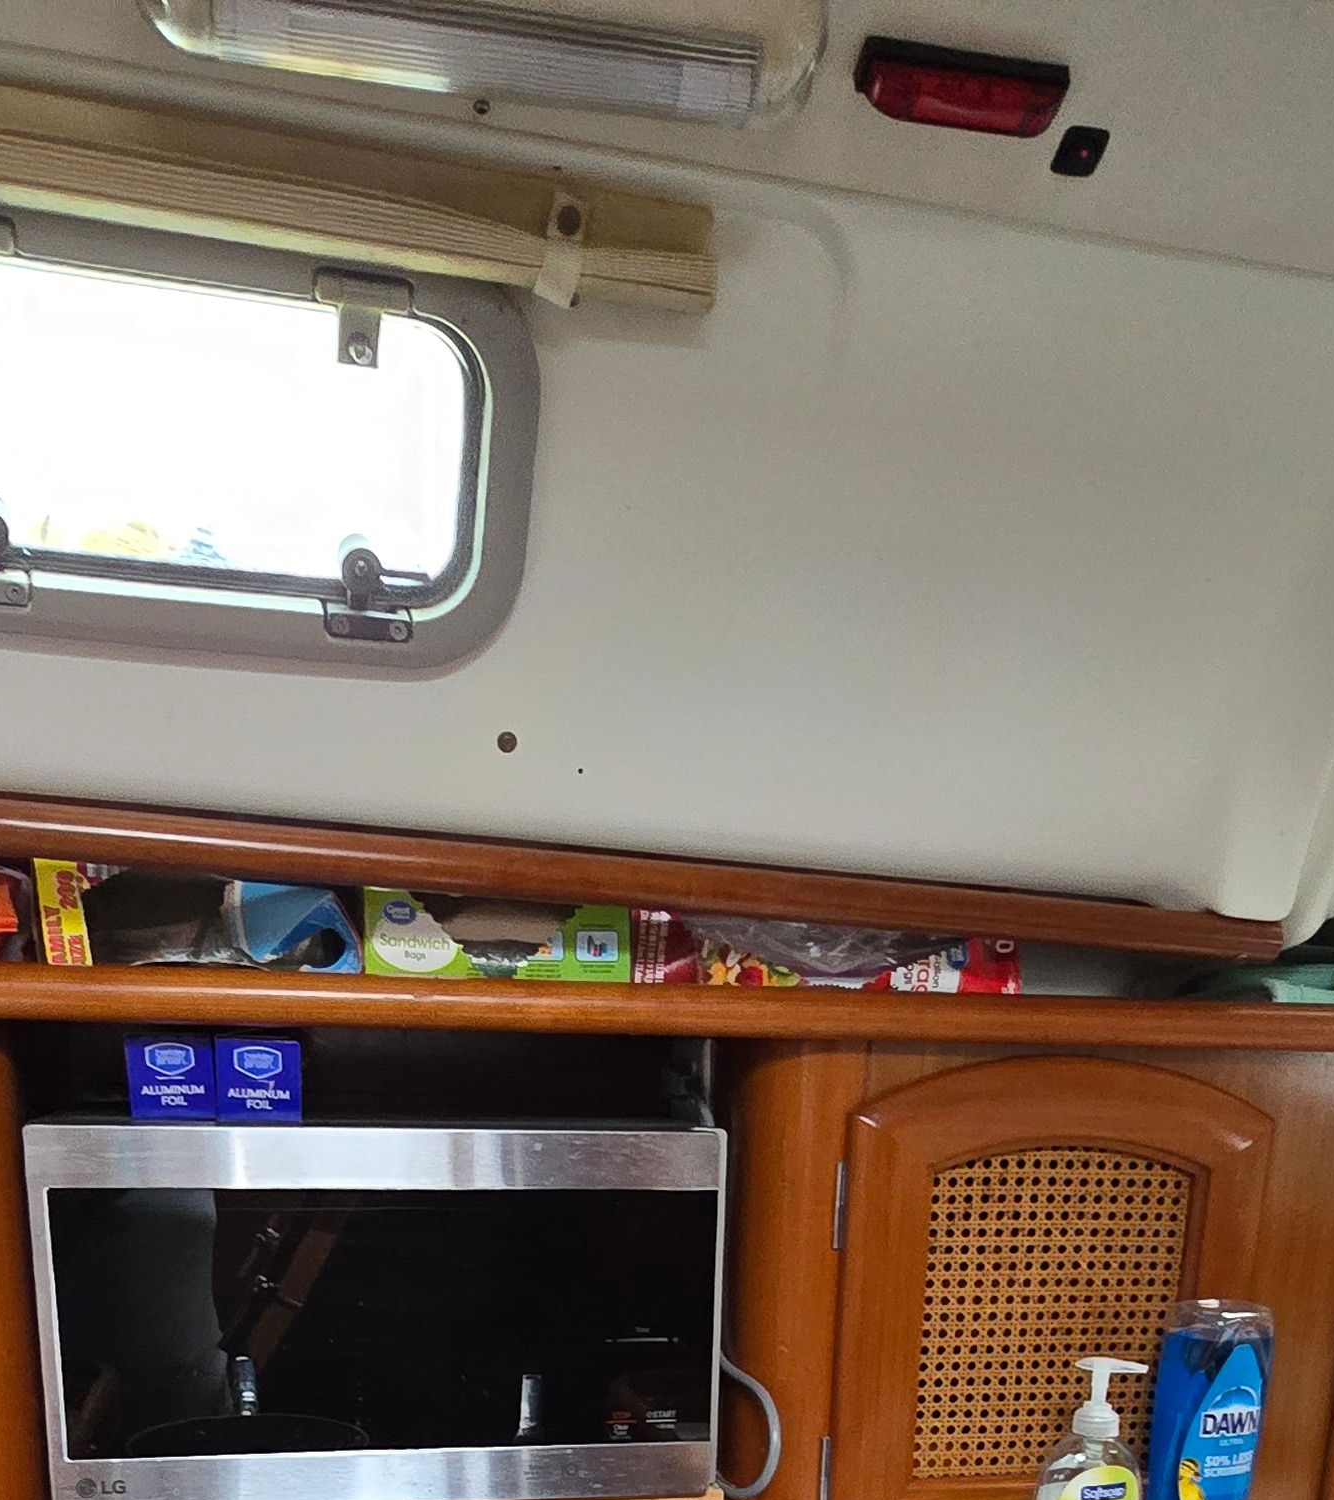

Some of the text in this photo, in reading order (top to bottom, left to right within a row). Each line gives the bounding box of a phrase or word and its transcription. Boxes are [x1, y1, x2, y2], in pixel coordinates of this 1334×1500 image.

[42, 905, 67, 964] AMILY
[379, 932, 451, 951] Sandwich
[68, 934, 87, 965] IZE
[403, 950, 426, 961] Bags
[141, 1084, 206, 1096] ALUMINUM
[227, 1087, 290, 1100] ALUMINUM
[161, 1095, 188, 1106] FOIL
[246, 1099, 273, 1110] FOIL
[1201, 1409, 1259, 1435] DAWN
[101, 1479, 127, 1495] LG
